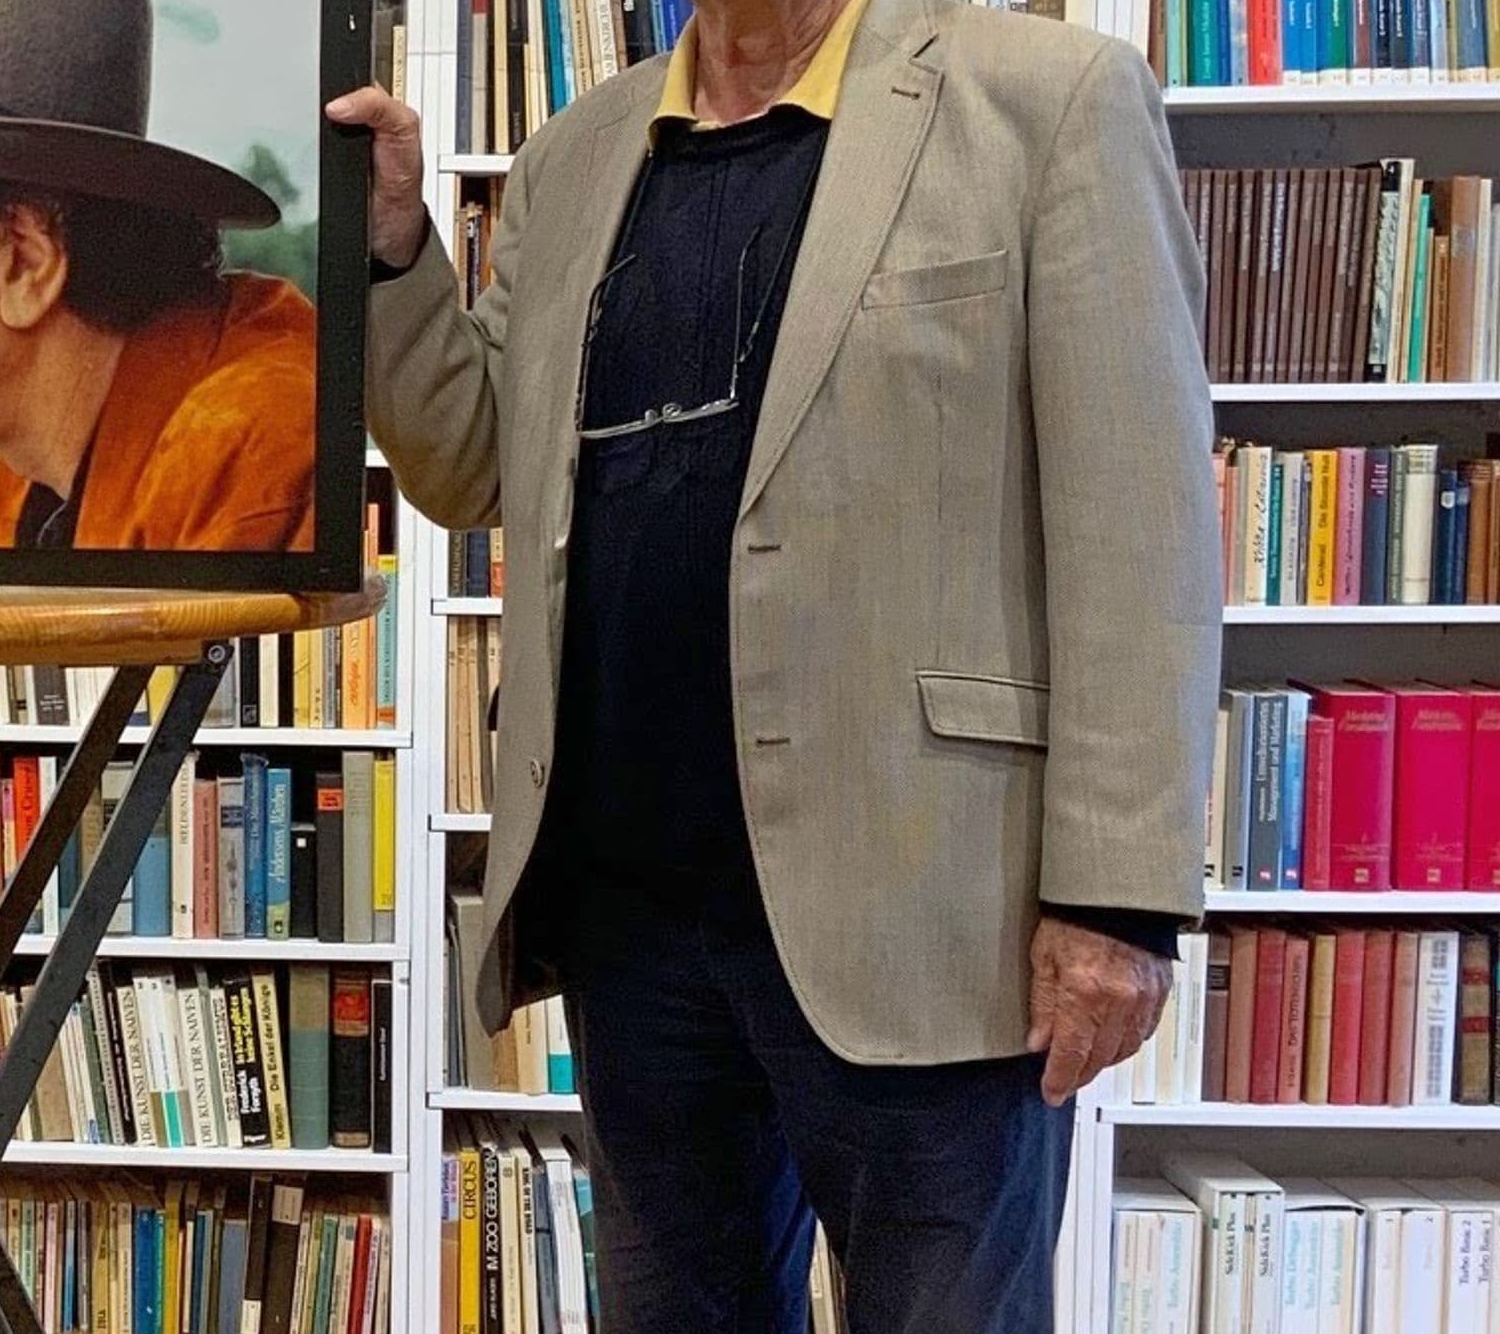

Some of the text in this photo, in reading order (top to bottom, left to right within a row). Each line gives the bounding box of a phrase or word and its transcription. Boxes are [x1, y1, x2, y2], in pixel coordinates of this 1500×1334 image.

[597, 4, 616, 78] ARIENKIRCHE
[1267, 701, 1284, 822] Management und Marketing
[266, 783, 287, 884] Andersens Märchen
[230, 1007, 243, 1025] gibt
[239, 987, 256, 1063] keine Schlangen
[232, 1026, 244, 1053] Irland
[121, 990, 152, 1141] DIE KUNST DER NAIVEN
[183, 993, 212, 1143] DIE KUNST DER NAIVEN
[259, 984, 285, 1141] Klemm Die Enkel der Könige
[235, 1070, 250, 1114] Frederick
[248, 1076, 262, 1113] Forsyth
[462, 1160, 477, 1221] CIRCUS
[483, 1151, 499, 1271] IM ZOO GEBOREN
[1224, 1212, 1237, 1276] SideKick Plus
[1259, 1214, 1271, 1234] Plus
[1459, 1229, 1471, 1254] Basic
[1479, 1228, 1491, 1252] Basic
[1285, 1274, 1298, 1306] Turbo
[1457, 1256, 1471, 1285] Turbo
[1477, 1254, 1491, 1283] Turbo
[1167, 1280, 1178, 1309] Turbo
